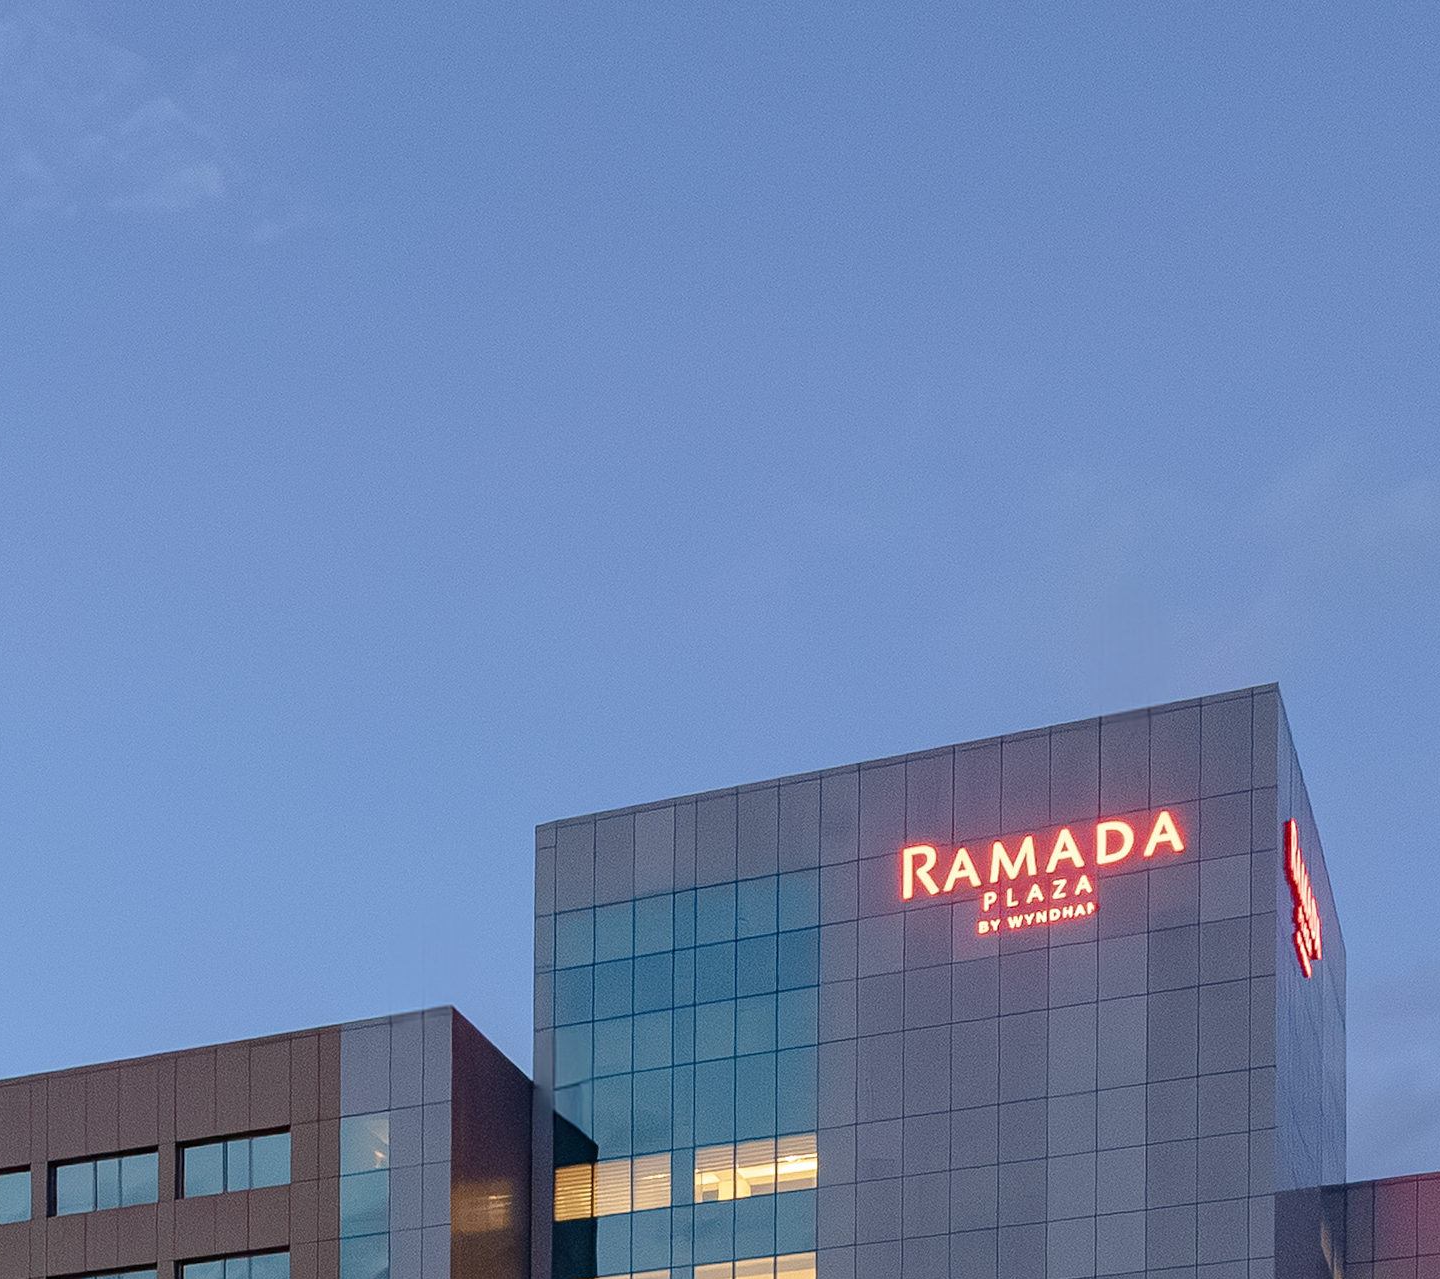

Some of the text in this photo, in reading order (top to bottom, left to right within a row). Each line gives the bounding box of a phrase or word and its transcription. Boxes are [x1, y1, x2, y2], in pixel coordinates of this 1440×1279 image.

[901, 809, 1186, 901] RAMADA
[982, 873, 1094, 912] PLAZA
[977, 918, 1002, 935] BY
